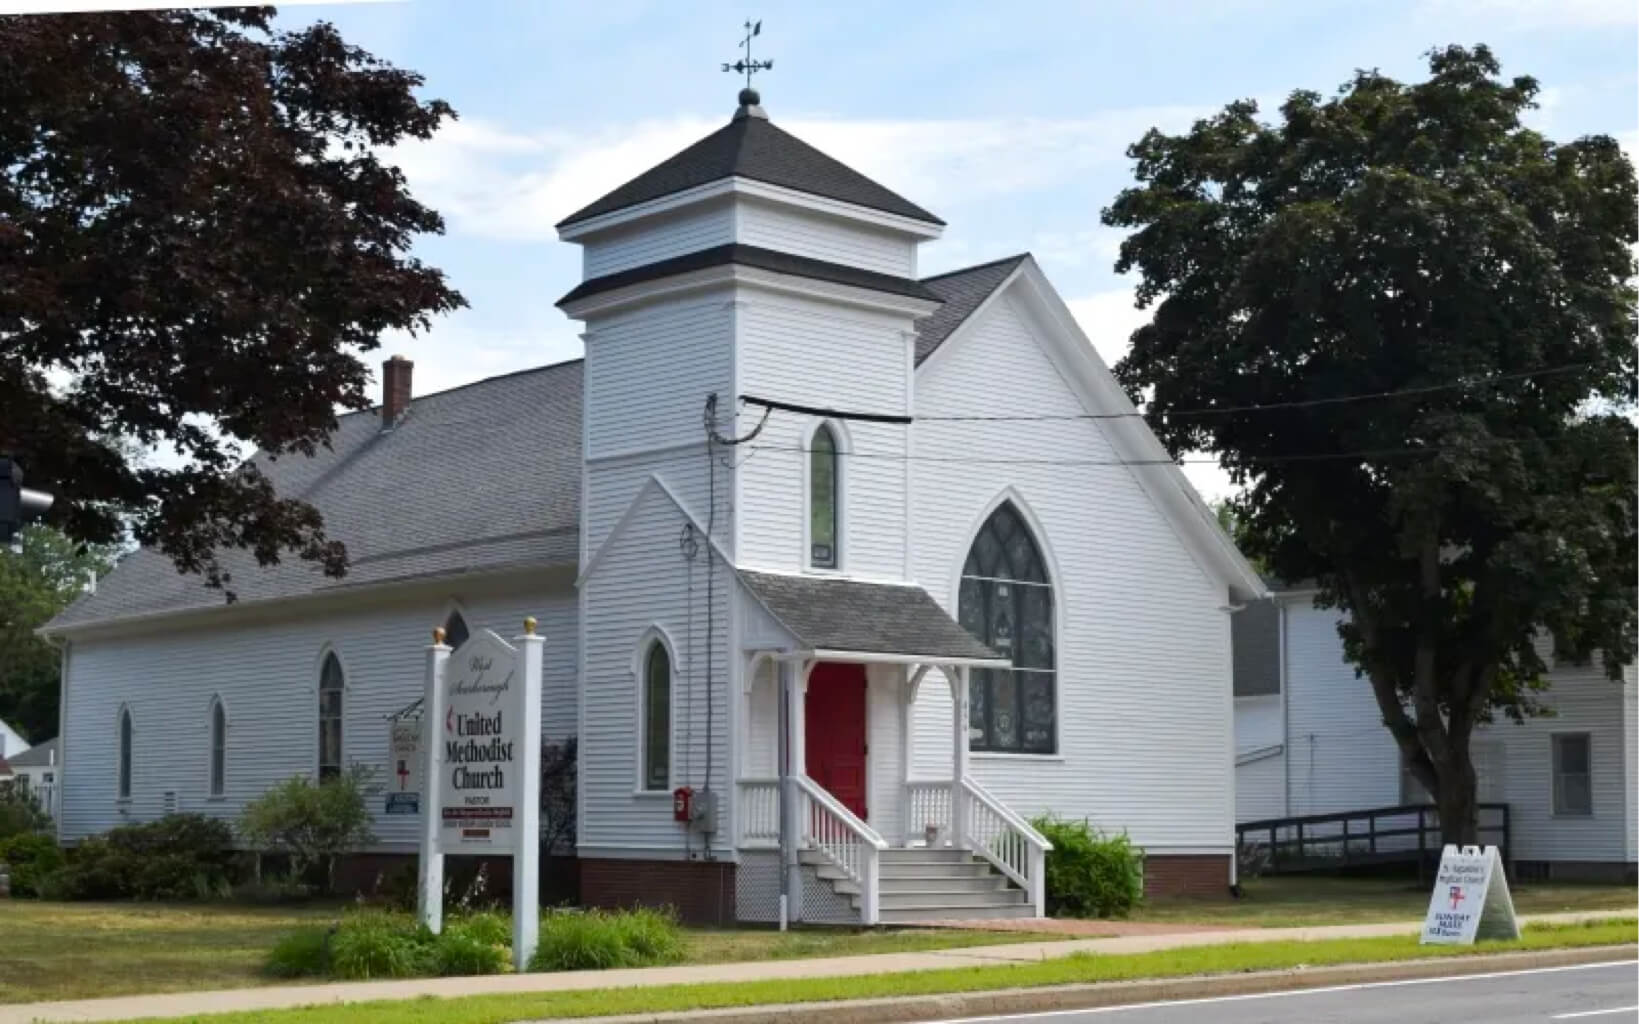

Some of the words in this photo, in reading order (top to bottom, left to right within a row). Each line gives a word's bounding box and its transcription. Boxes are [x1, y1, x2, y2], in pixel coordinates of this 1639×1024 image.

[457, 710, 503, 736] United
[445, 737, 514, 763] Methodist
[452, 764, 504, 790] Church
[1435, 912, 1471, 921] SUNDAY
